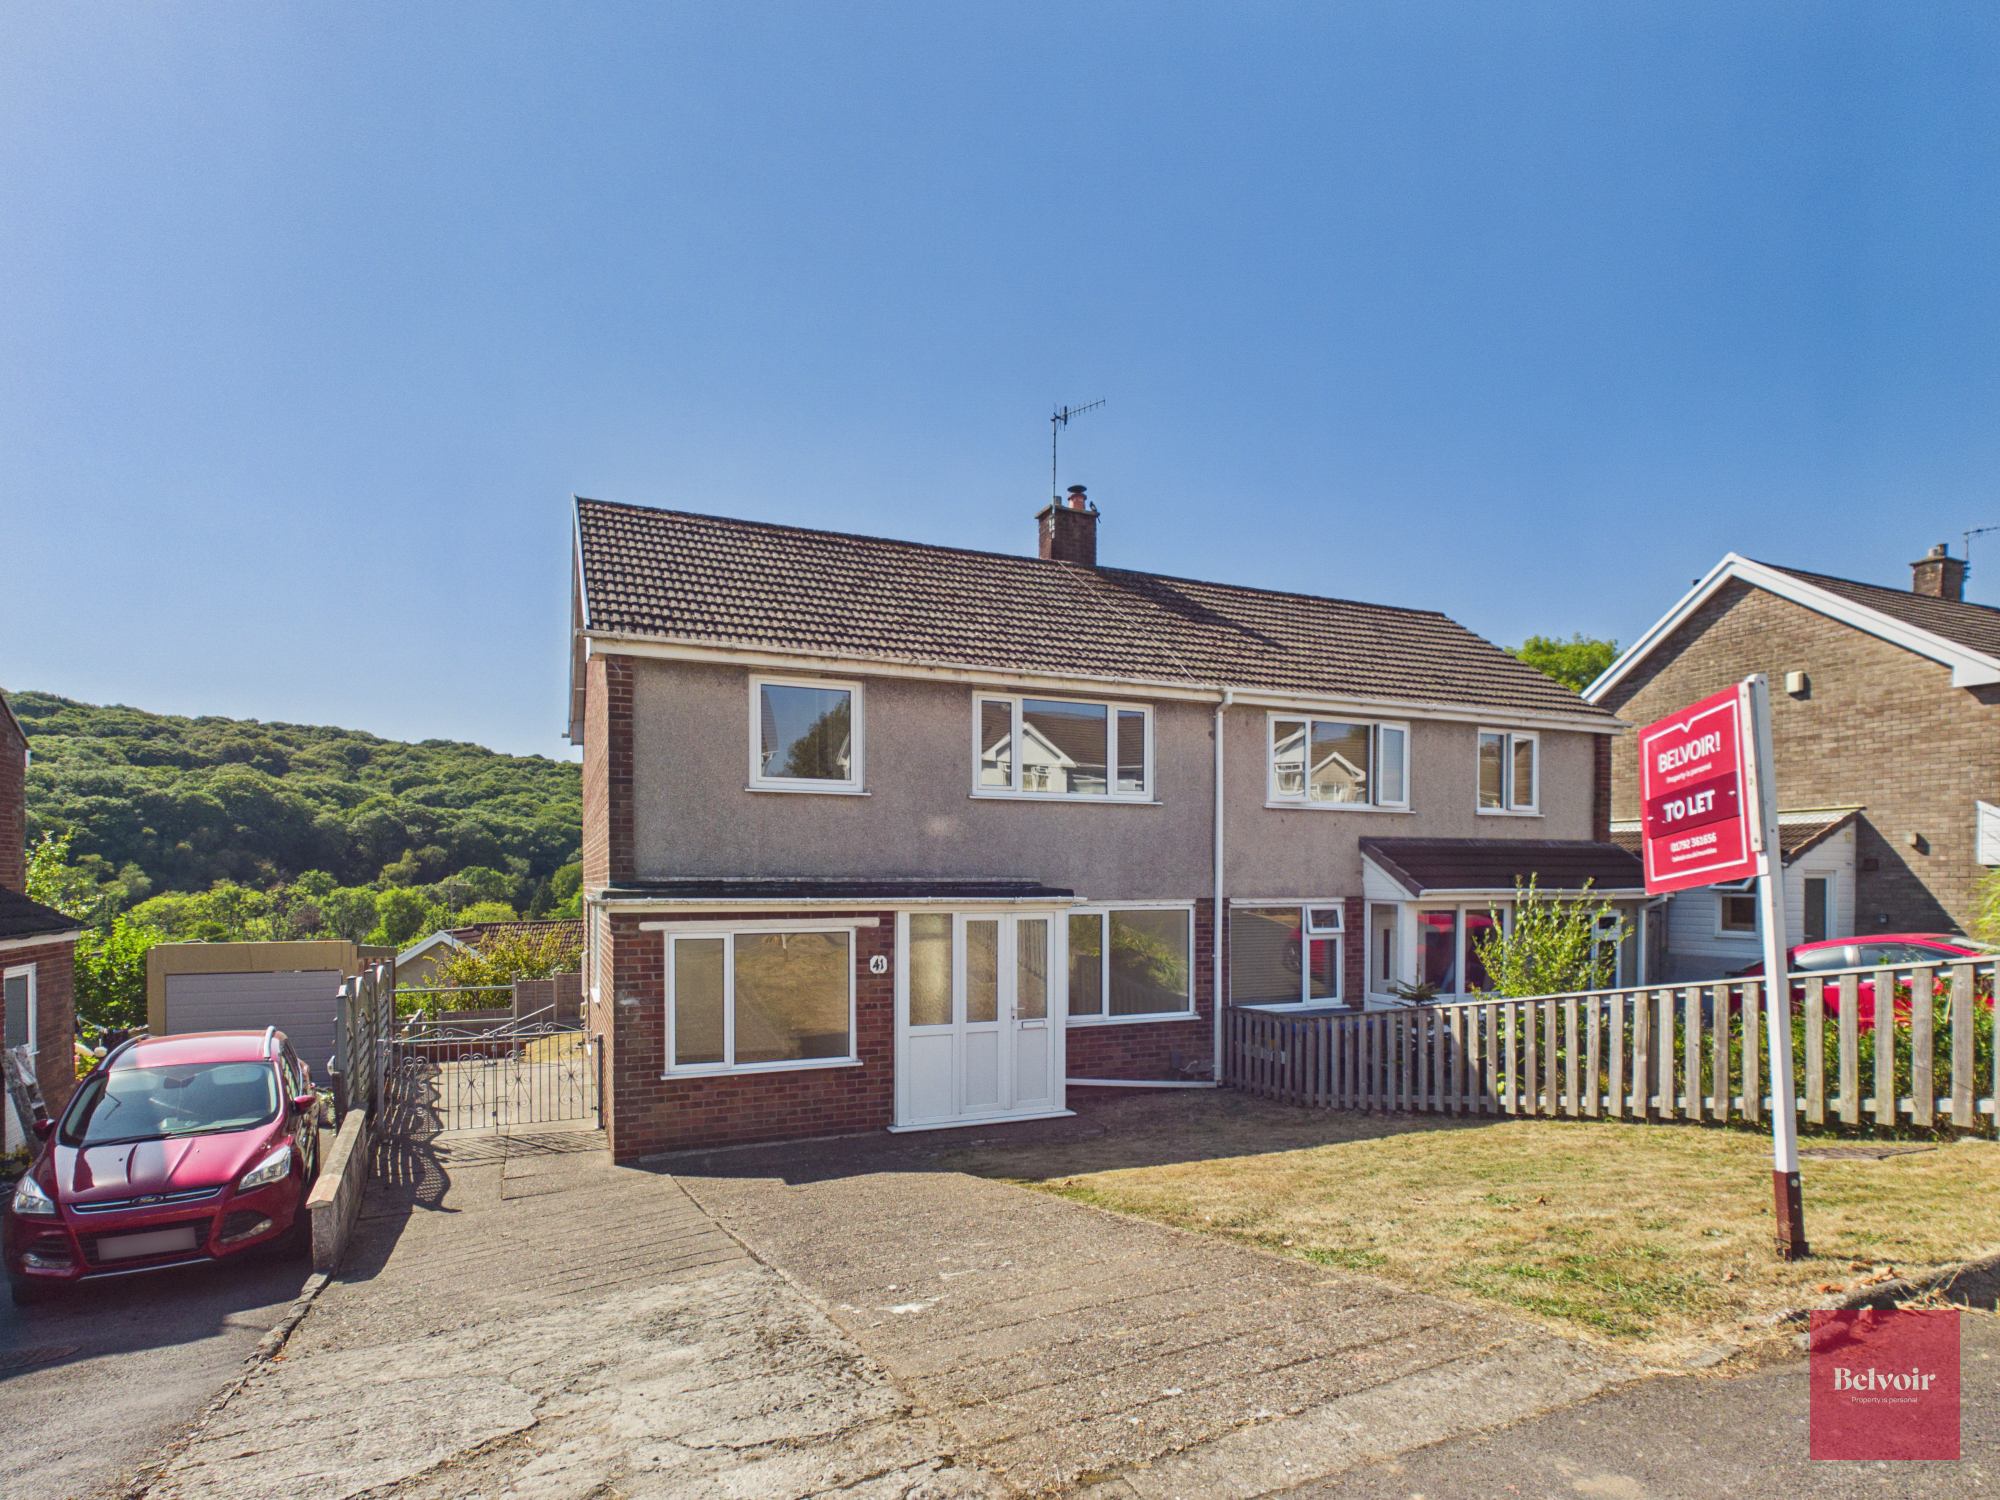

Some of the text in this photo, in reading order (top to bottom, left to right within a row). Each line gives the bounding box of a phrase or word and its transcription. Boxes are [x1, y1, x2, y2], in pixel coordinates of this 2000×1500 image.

[1657, 731, 1721, 773] BELVOIR!
[1663, 789, 1716, 823] TO LET
[872, 958, 884, 971] 41
